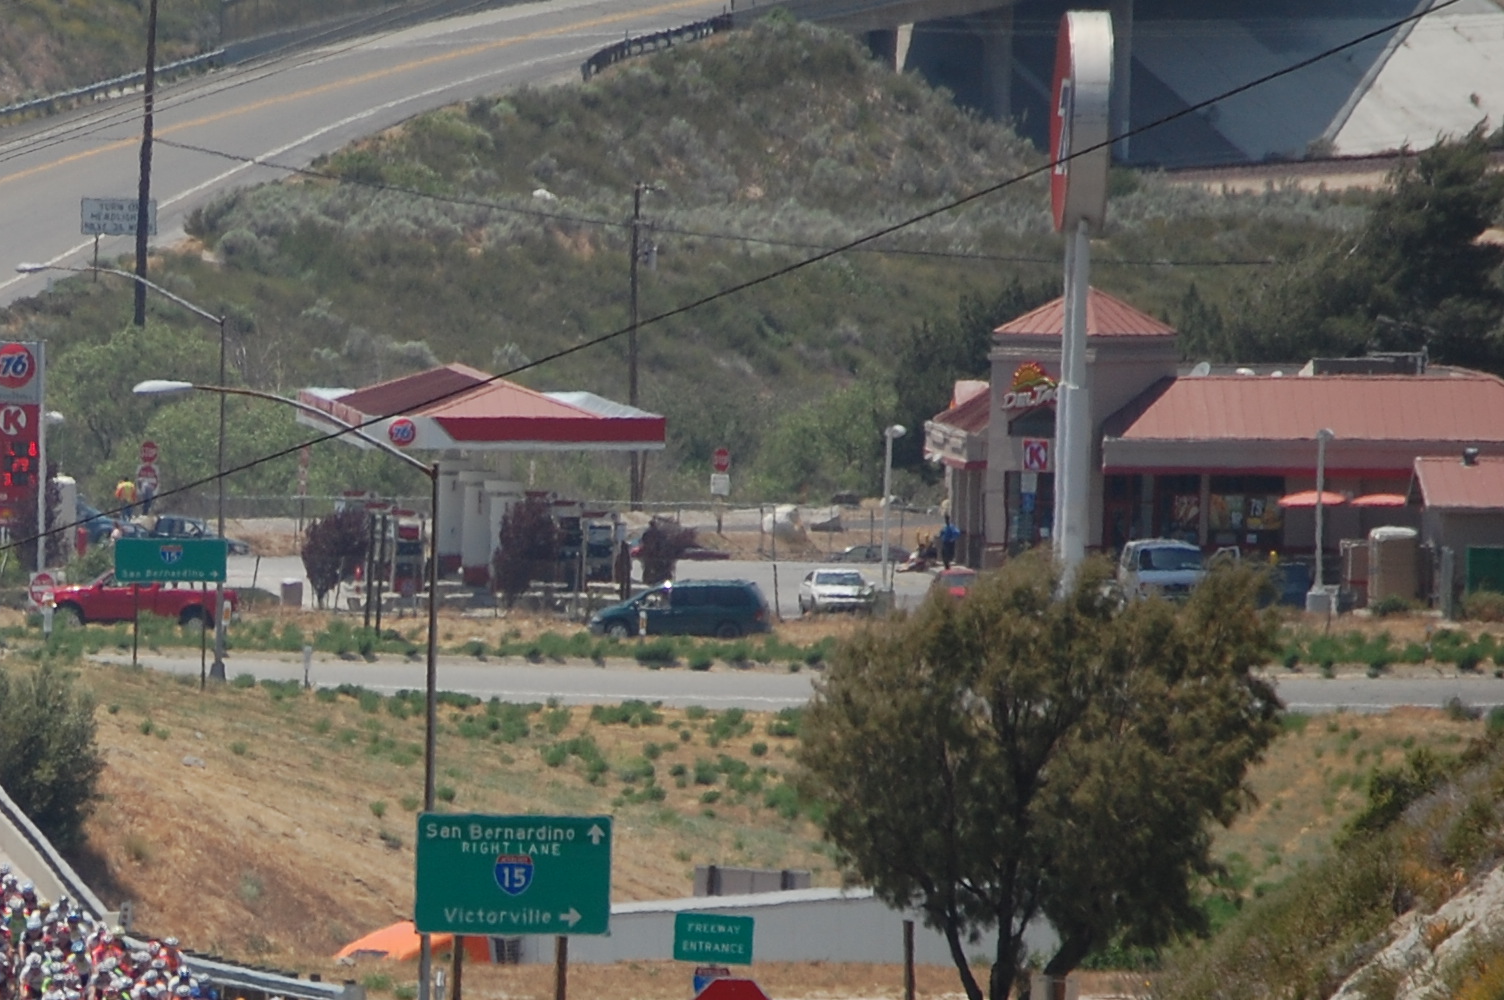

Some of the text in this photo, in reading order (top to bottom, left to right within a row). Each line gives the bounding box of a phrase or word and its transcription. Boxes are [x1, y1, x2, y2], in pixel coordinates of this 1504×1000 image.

[91, 213, 137, 221] HEADLIGH
[0, 354, 28, 377] 76
[3, 409, 21, 432] K
[392, 423, 412, 440] 76
[165, 552, 177, 561] 15
[145, 570, 205, 578] Bernardino
[426, 824, 575, 840] San Bernardino
[462, 842, 561, 855] RIGHT LANE
[503, 867, 525, 888] 15
[445, 907, 551, 924] Victorville
[687, 923, 741, 934] FREEWAY
[682, 942, 744, 954] ENTRANCE
